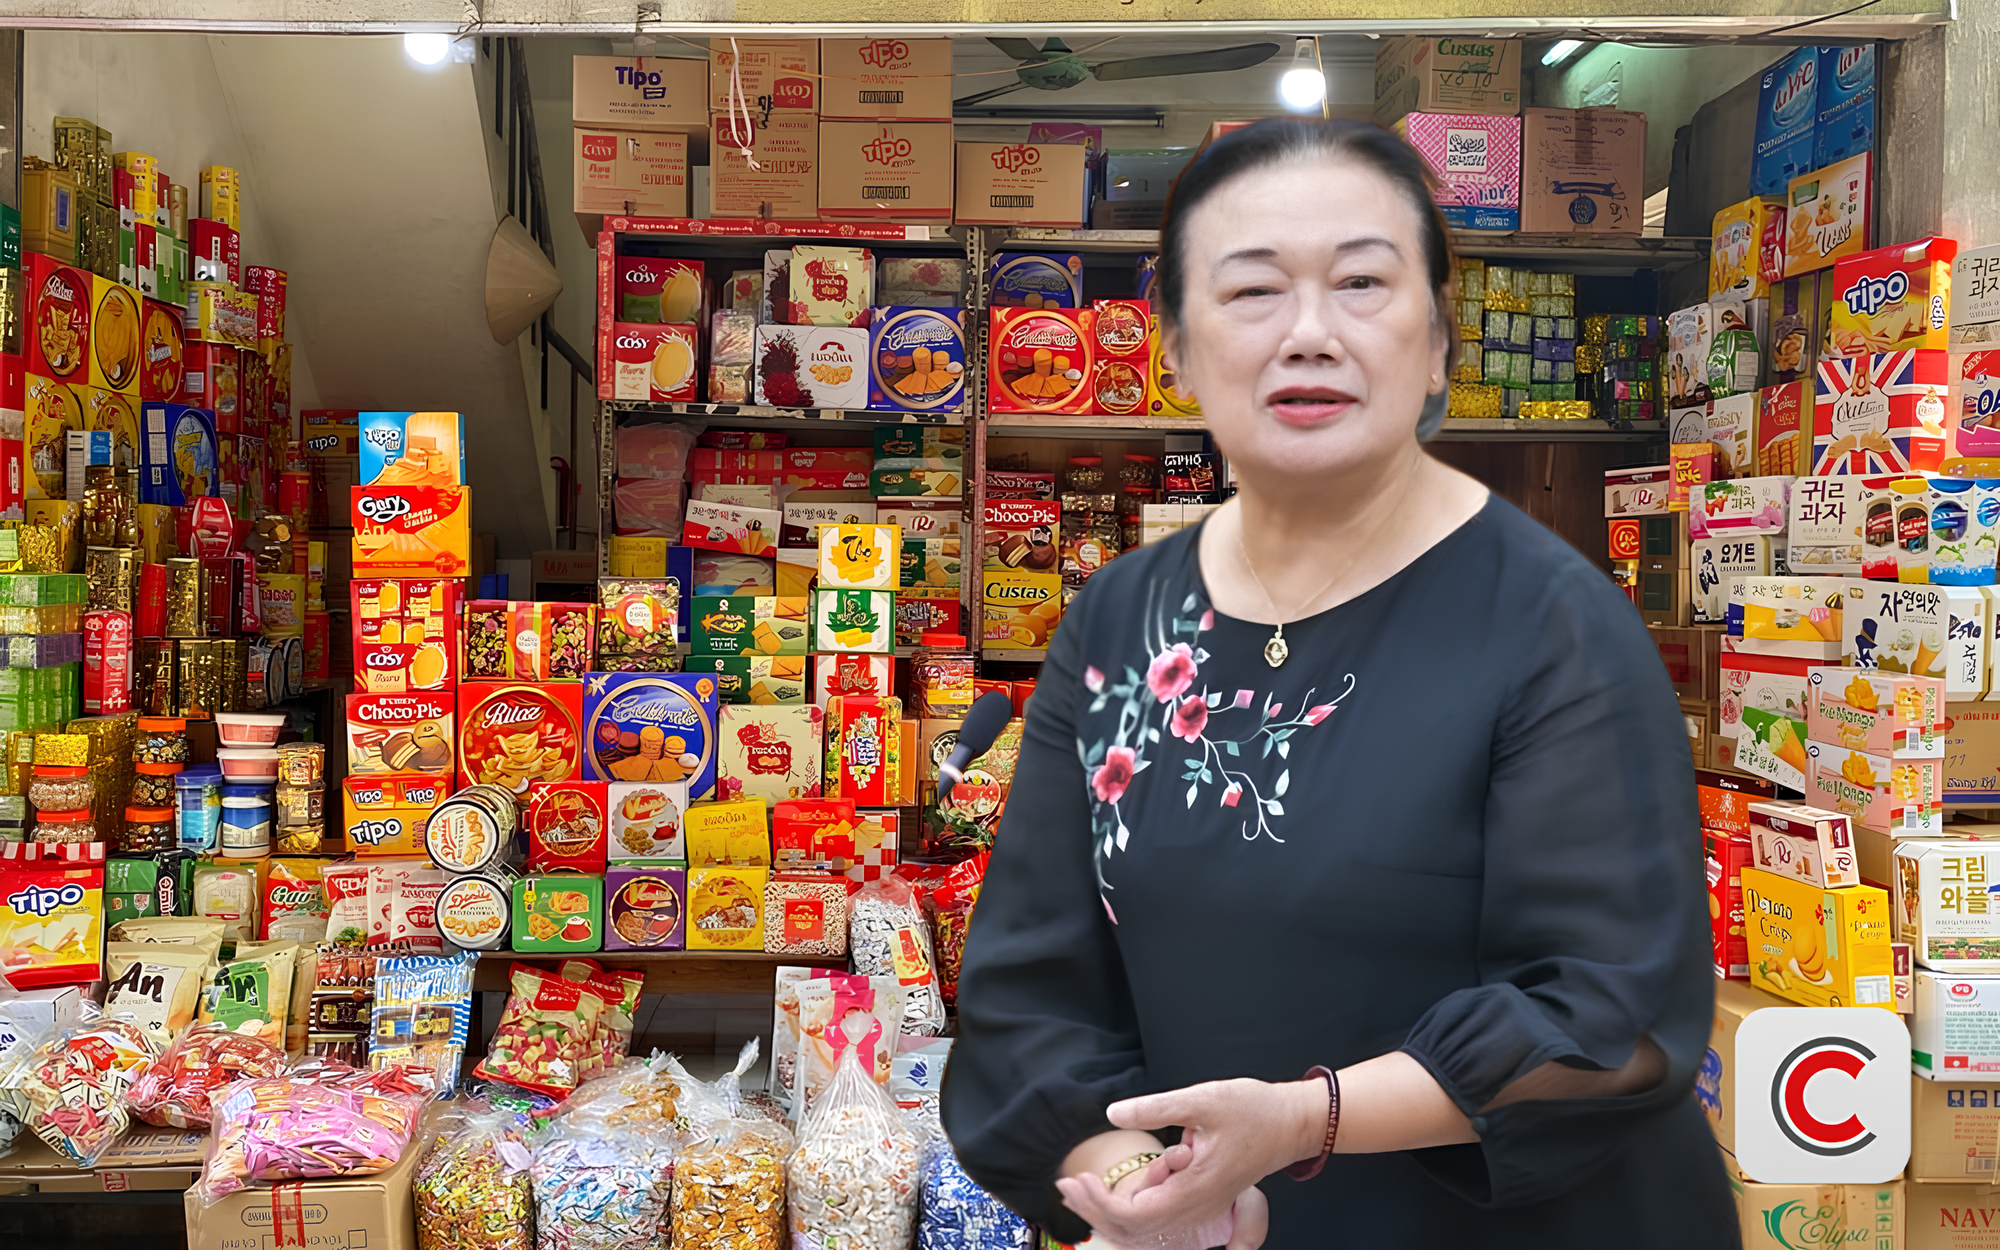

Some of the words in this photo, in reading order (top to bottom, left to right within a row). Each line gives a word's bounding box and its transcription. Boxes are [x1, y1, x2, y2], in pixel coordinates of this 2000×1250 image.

[1799, 502, 1847, 526] 과자
[366, 652, 404, 666] COSY
[349, 818, 402, 846] Tipo
[1941, 856, 1985, 883] 크림
[7, 883, 85, 917] Tipo
[1941, 885, 1990, 914] 와플
[1799, 1205, 1870, 1250] Elysa
[1940, 1208, 2000, 1228] NAV
